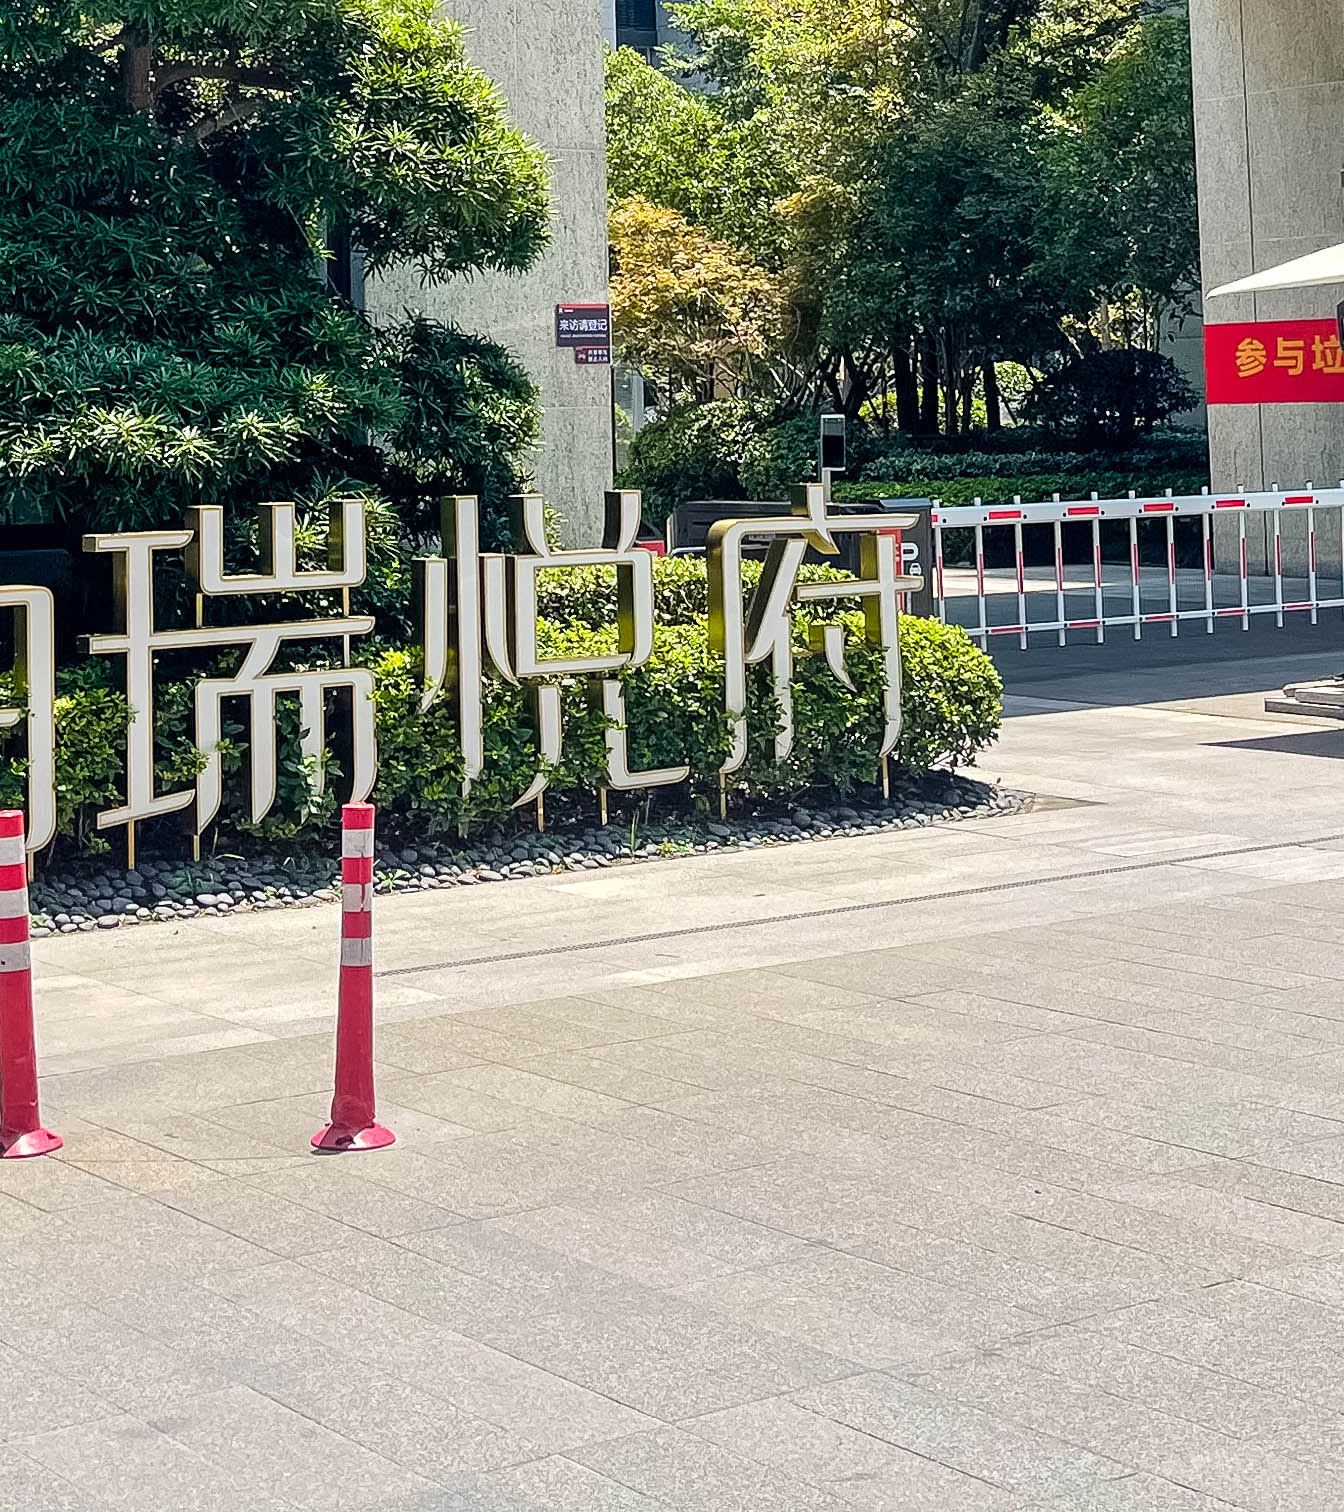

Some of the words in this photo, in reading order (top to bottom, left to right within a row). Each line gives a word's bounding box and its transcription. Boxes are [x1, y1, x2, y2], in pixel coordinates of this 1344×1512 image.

[560, 319, 608, 331] 来访请登记
